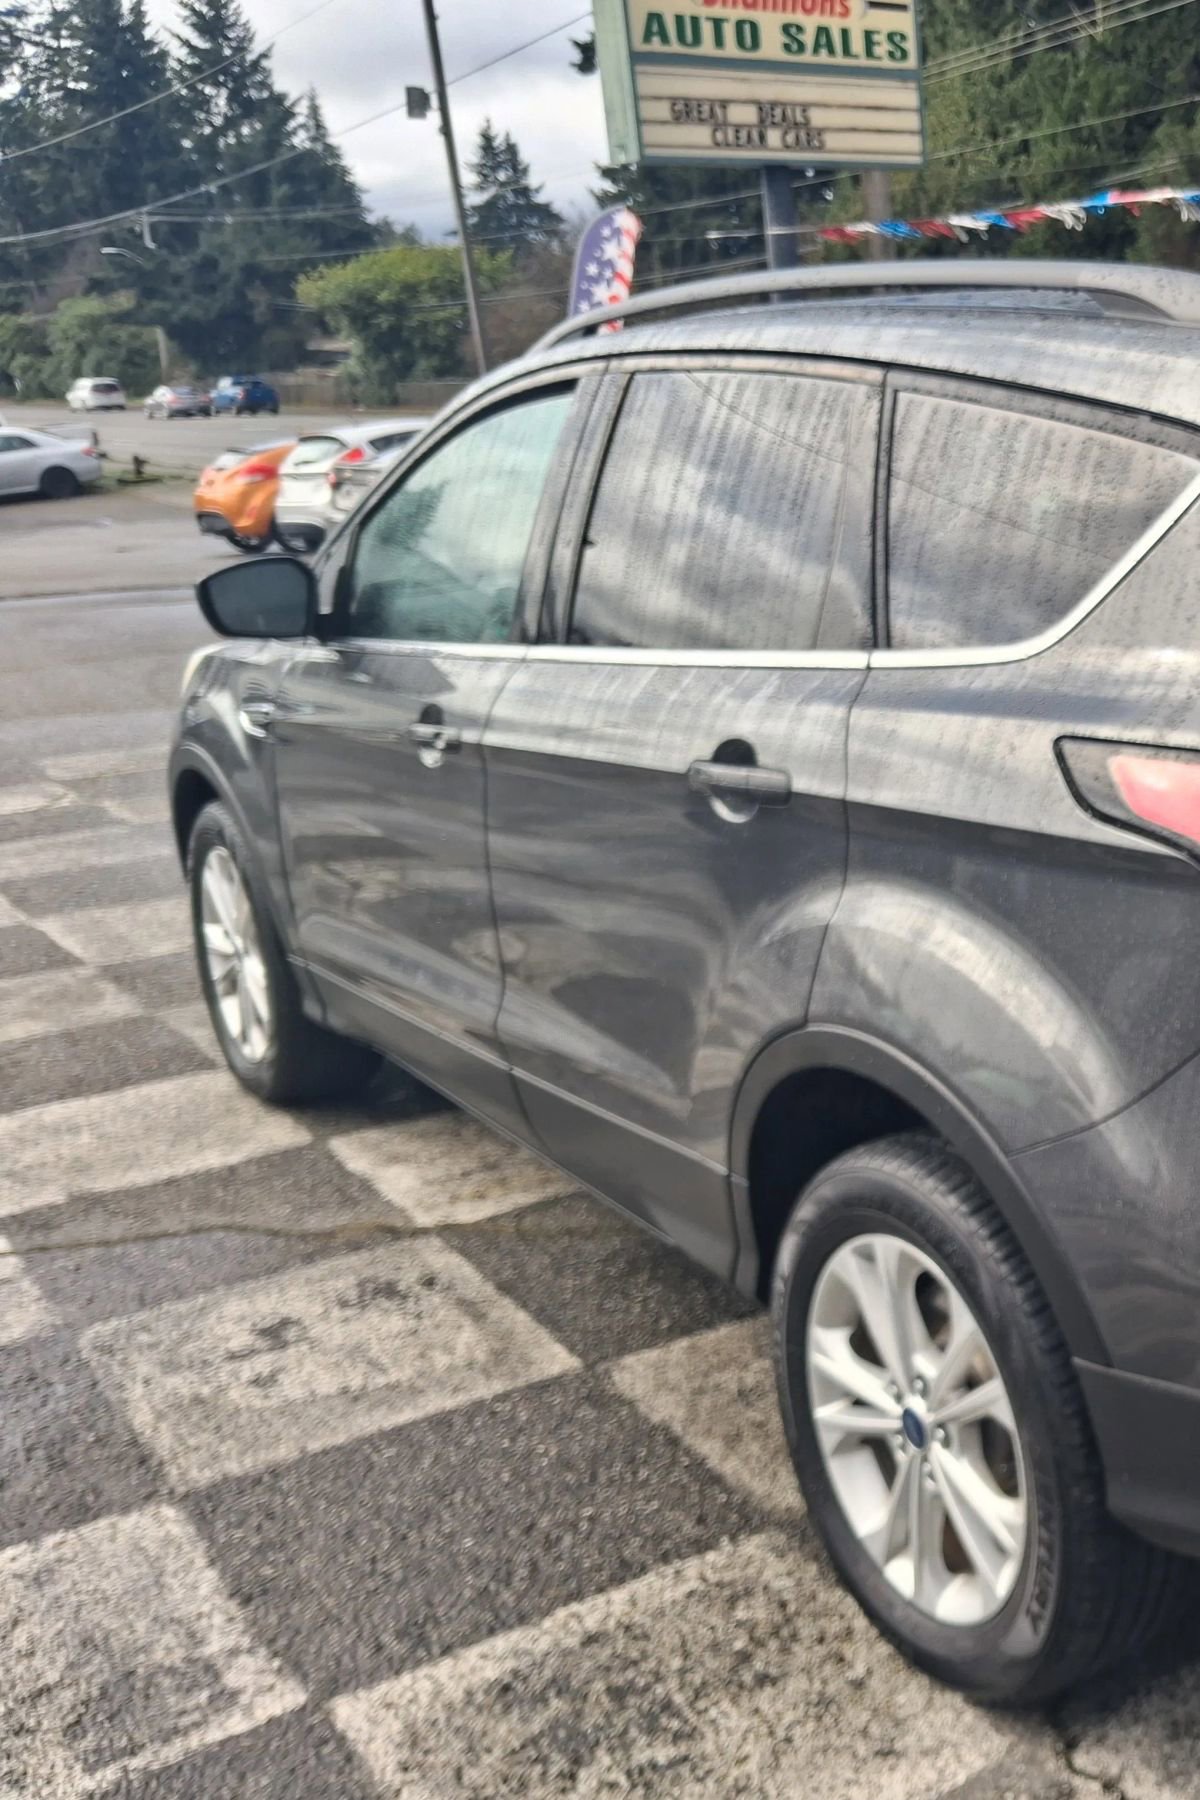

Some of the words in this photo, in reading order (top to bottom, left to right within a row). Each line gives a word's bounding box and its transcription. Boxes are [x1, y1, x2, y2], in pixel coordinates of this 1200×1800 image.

[642, 12, 760, 51] AUTO
[781, 23, 909, 61] SALES
[670, 99, 728, 122] GREAT
[758, 103, 811, 127] DEALS
[711, 126, 768, 148] CLEAN
[781, 129, 826, 150] CARS
